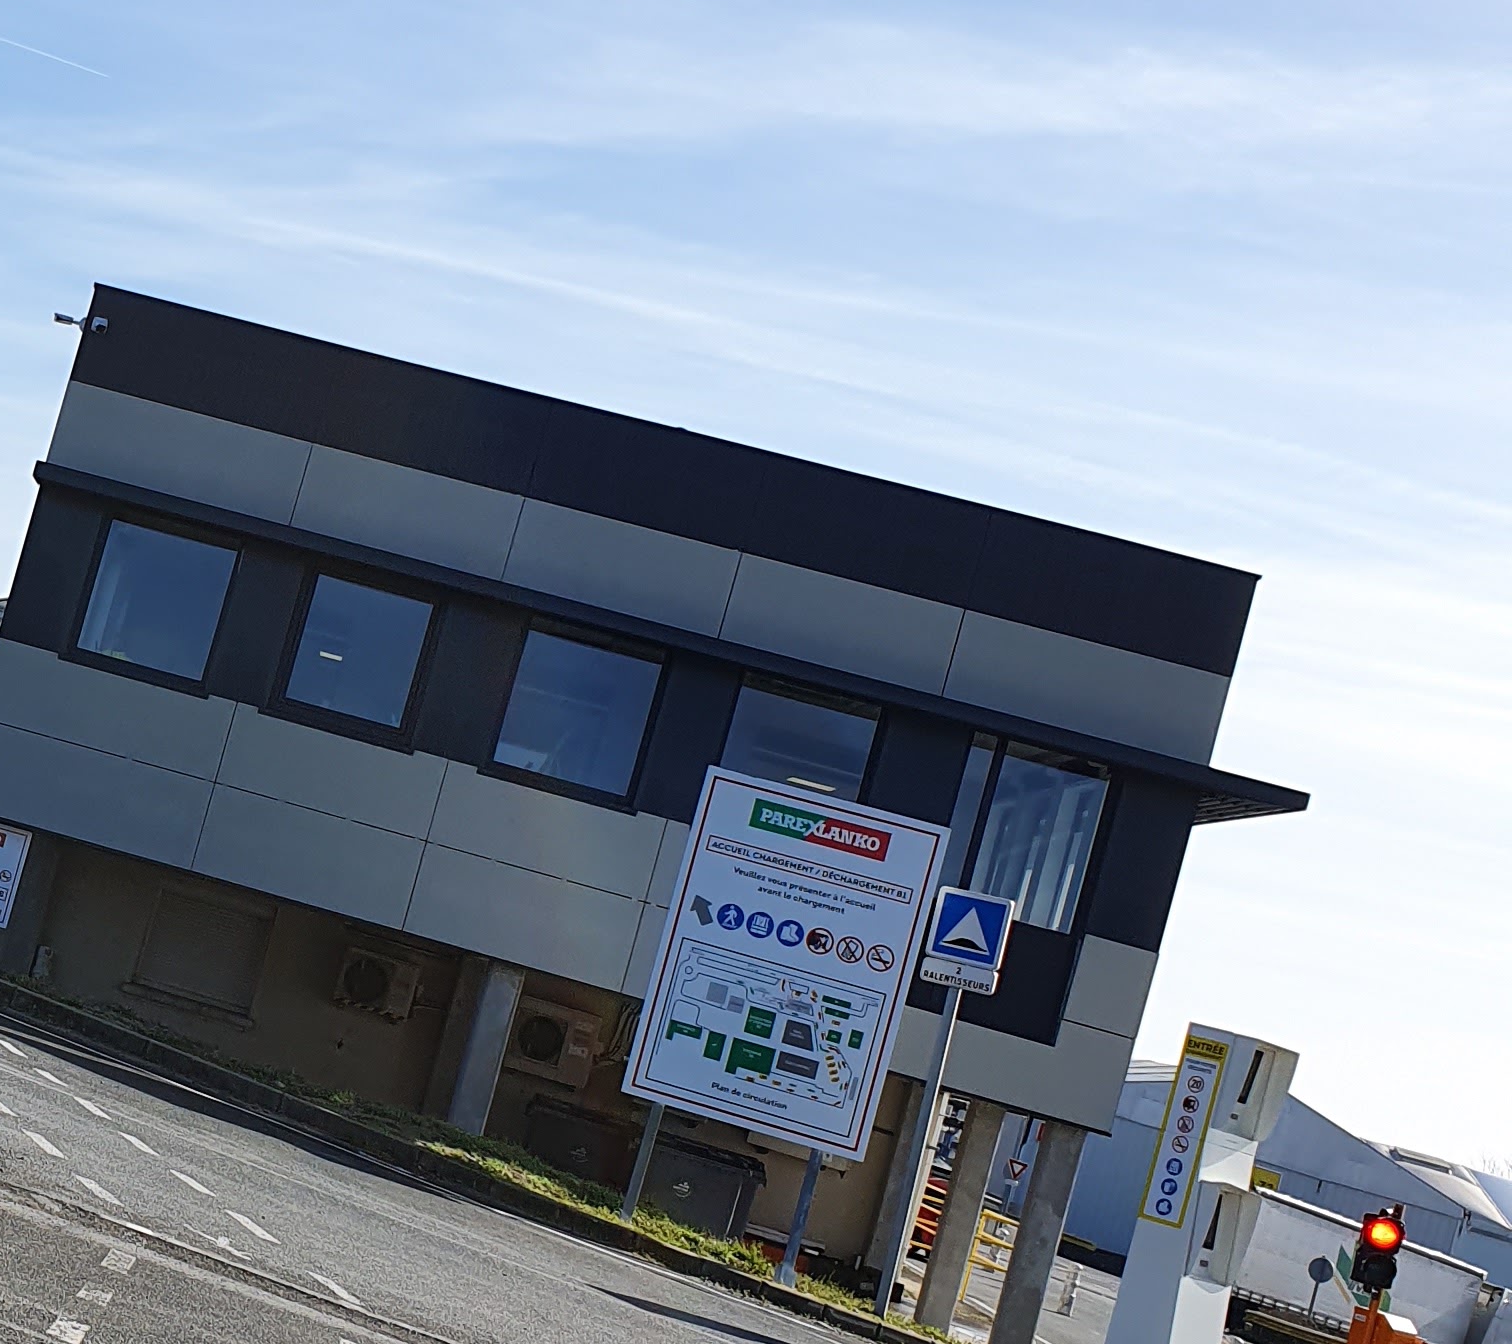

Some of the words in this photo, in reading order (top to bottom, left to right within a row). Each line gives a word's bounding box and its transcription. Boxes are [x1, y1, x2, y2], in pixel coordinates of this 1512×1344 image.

[759, 807, 881, 852] PAREXLANKO
[711, 841, 751, 858] ACCUEIL
[752, 851, 814, 875] CHARGEMENT
[821, 867, 895, 897] DÉCHARGEMENT
[733, 866, 766, 882] Veuillez
[767, 876, 788, 887] vous
[757, 886, 782, 898] avant
[792, 895, 846, 915] chargement
[923, 969, 990, 992] RALENTISSEURS
[955, 966, 962, 975] 2
[1187, 1039, 1226, 1056] ENTRÉE
[711, 1081, 729, 1094] Plan
[730, 1086, 741, 1096] de
[742, 1091, 788, 1110] circulation
